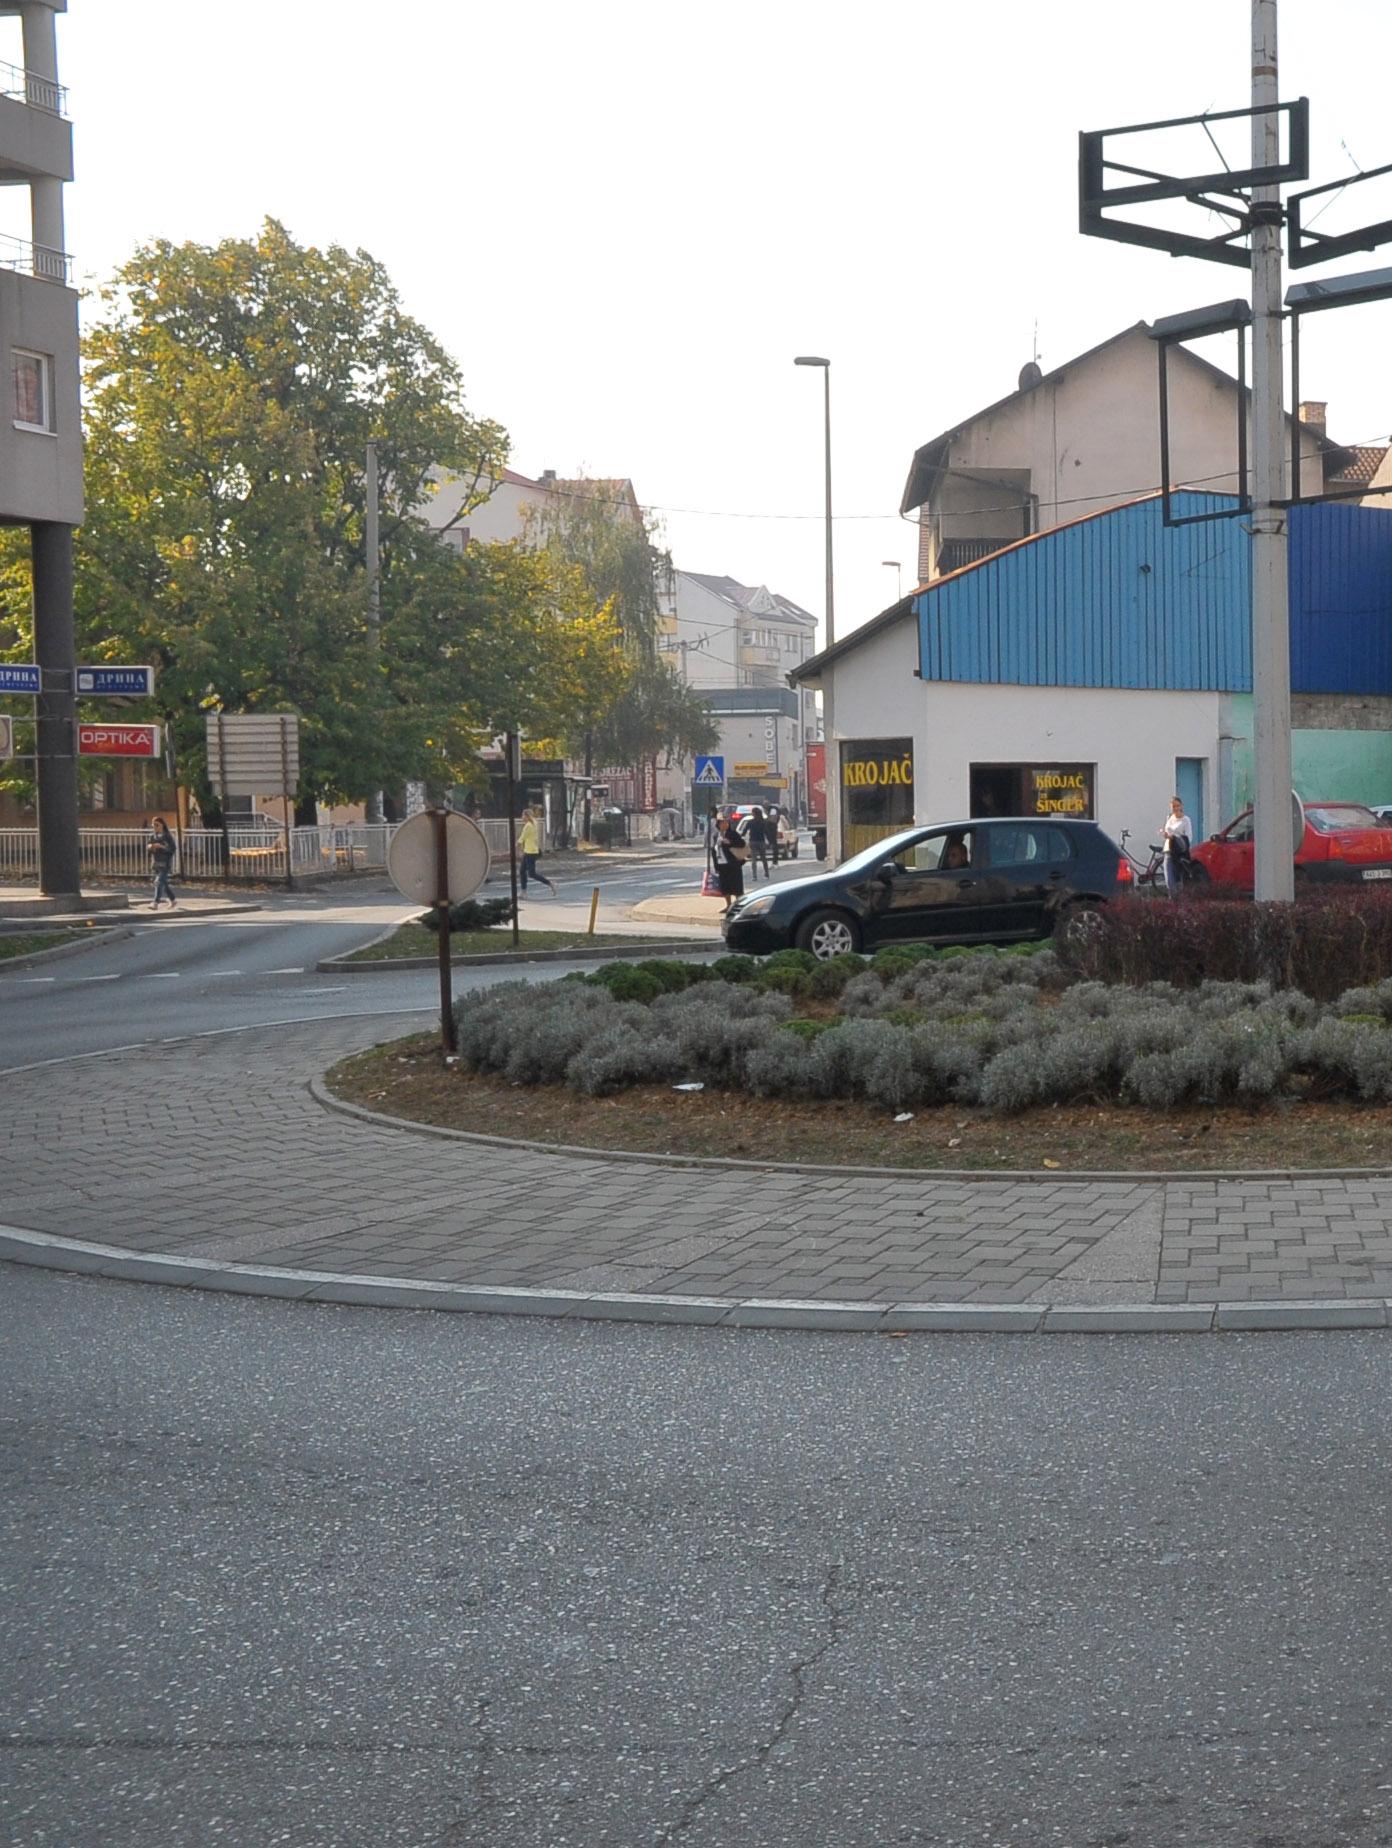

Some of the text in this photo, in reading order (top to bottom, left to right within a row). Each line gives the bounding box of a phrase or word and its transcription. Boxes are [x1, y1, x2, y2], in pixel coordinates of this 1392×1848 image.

[96, 673, 145, 684] ДРИНА
[80, 731, 150, 745] OPTIKA
[764, 716, 775, 765] SOBE
[843, 752, 913, 786] KROJAČ
[1036, 772, 1085, 788] KROJAČ
